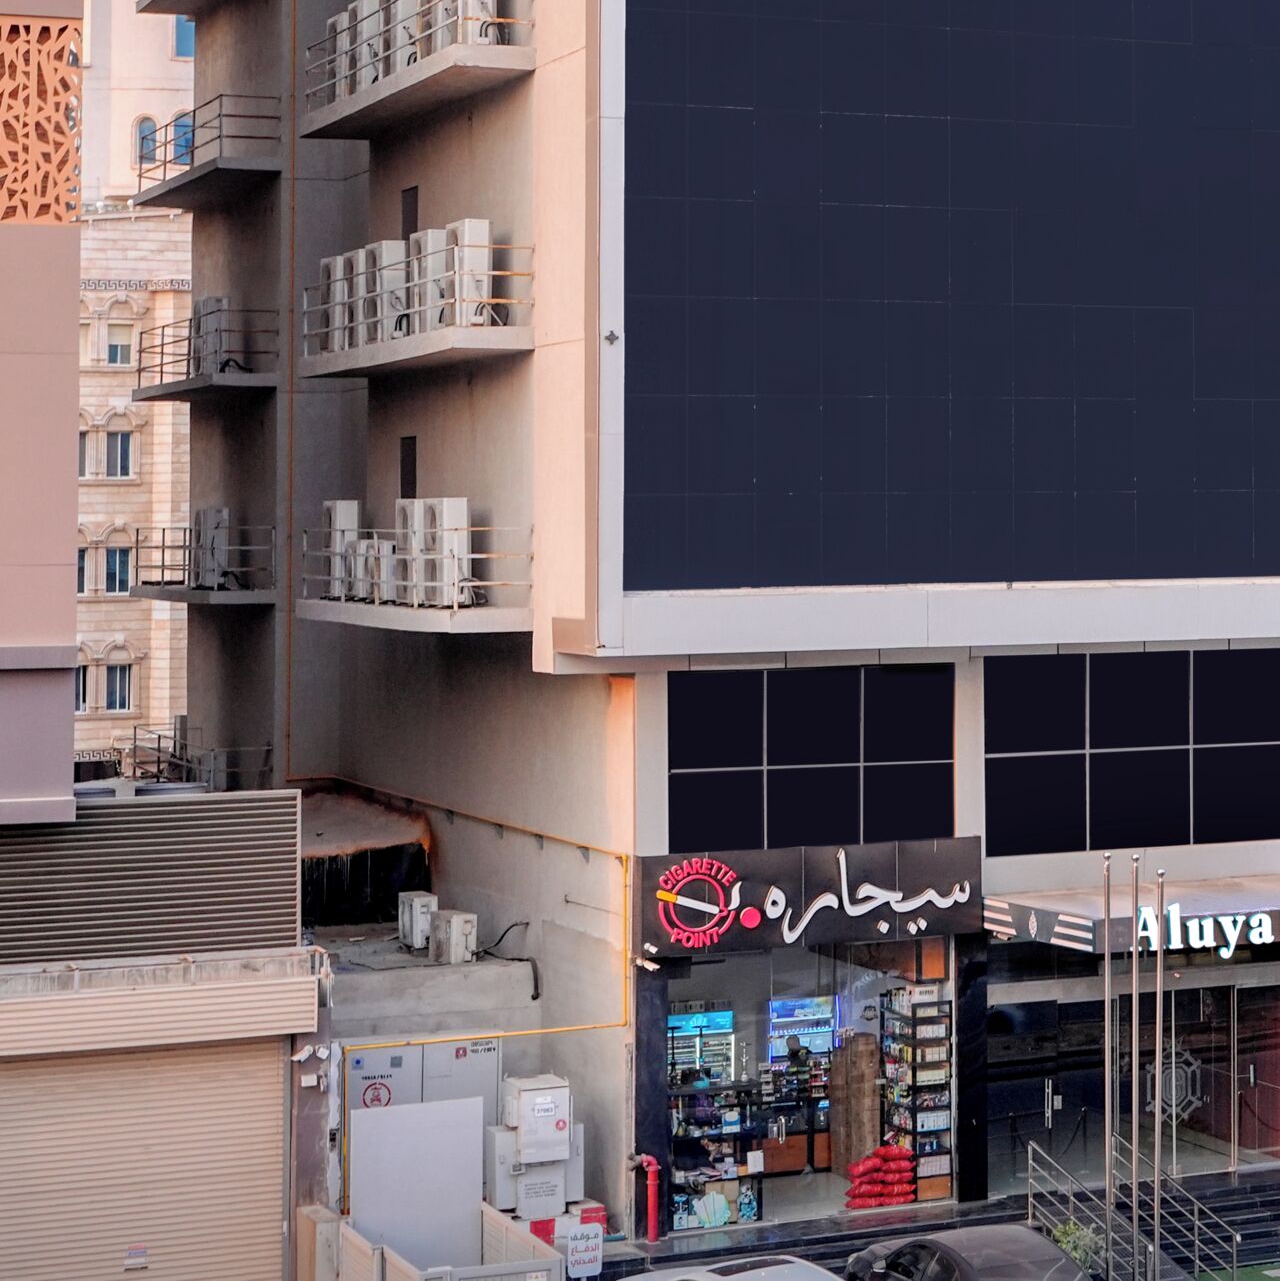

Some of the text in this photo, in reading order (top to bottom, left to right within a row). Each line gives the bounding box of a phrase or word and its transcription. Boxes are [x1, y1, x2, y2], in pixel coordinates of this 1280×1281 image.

[658, 857, 738, 890] CIGARETTE
[669, 929, 723, 949] POINT
[1130, 902, 1275, 960] Aluya
[570, 1231, 600, 1242] موقف
[570, 1242, 600, 1256] الدفاع
[570, 1255, 599, 1268] المدني
